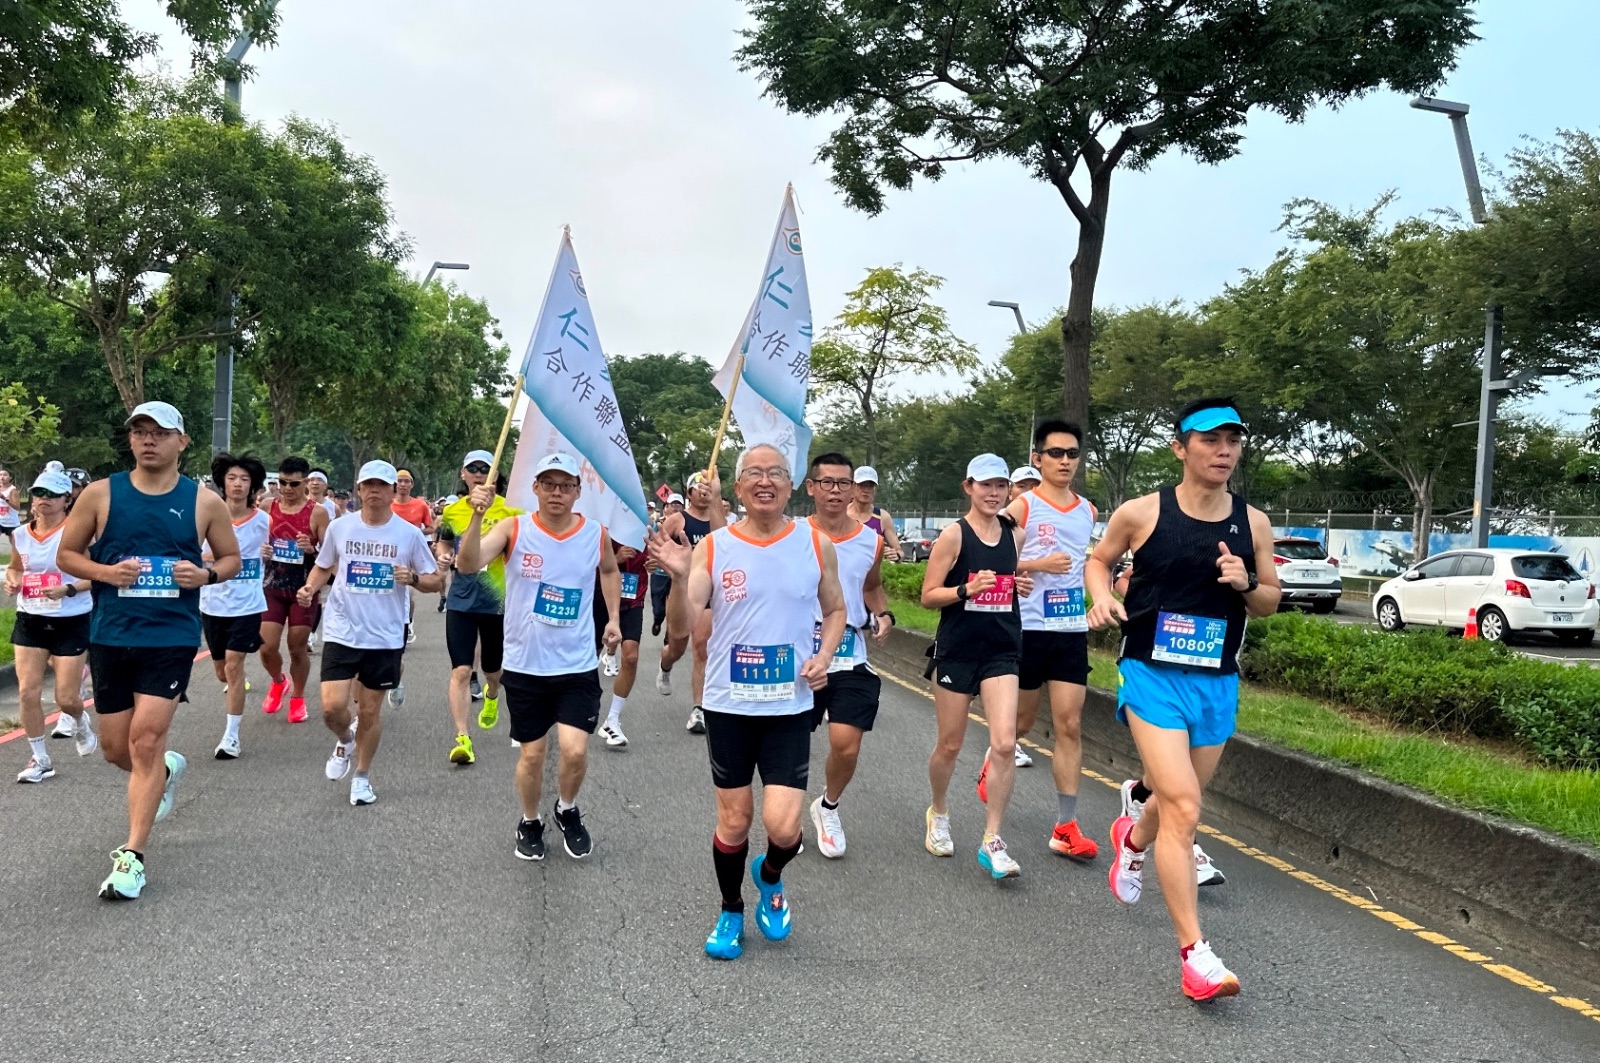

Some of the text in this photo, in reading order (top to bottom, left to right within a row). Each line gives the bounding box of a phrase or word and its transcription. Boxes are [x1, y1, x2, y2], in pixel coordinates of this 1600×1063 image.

[134, 575, 173, 587] 0338
[356, 576, 388, 587] 10275
[725, 592, 748, 603] CGMH
[977, 592, 1009, 602] 20171
[545, 603, 576, 616] 12238
[1053, 603, 1081, 615] 12179
[1169, 636, 1216, 654] 10809
[742, 667, 780, 680] 1111
